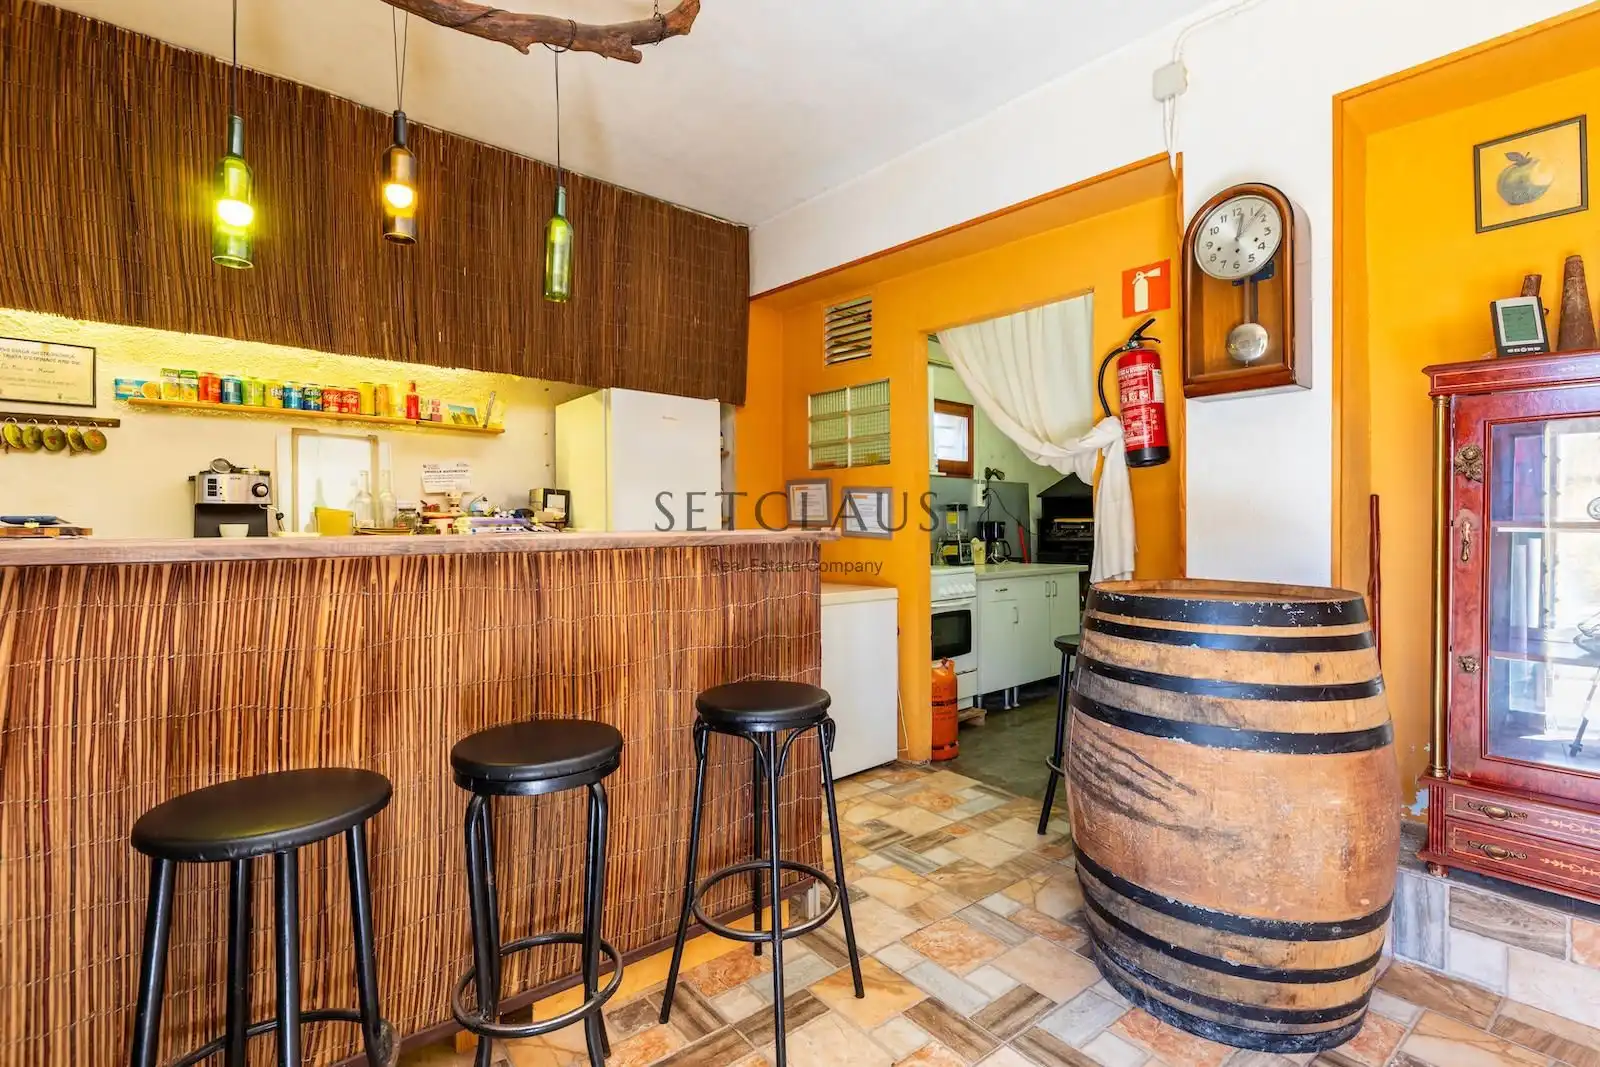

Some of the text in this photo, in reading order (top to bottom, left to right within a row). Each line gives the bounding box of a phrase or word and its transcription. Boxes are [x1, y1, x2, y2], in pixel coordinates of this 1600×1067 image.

[1232, 208, 1242, 217] 12
[1220, 215, 1227, 223] 11
[1260, 214, 1266, 222] 2
[1210, 226, 1219, 235] 10
[1264, 227, 1272, 236] 3
[1206, 241, 1213, 250] 9
[1258, 242, 1266, 250] 4
[1210, 253, 1217, 262] 8
[1248, 253, 1255, 263] 5
[1220, 260, 1227, 269] 7
[1233, 261, 1240, 269] 6
